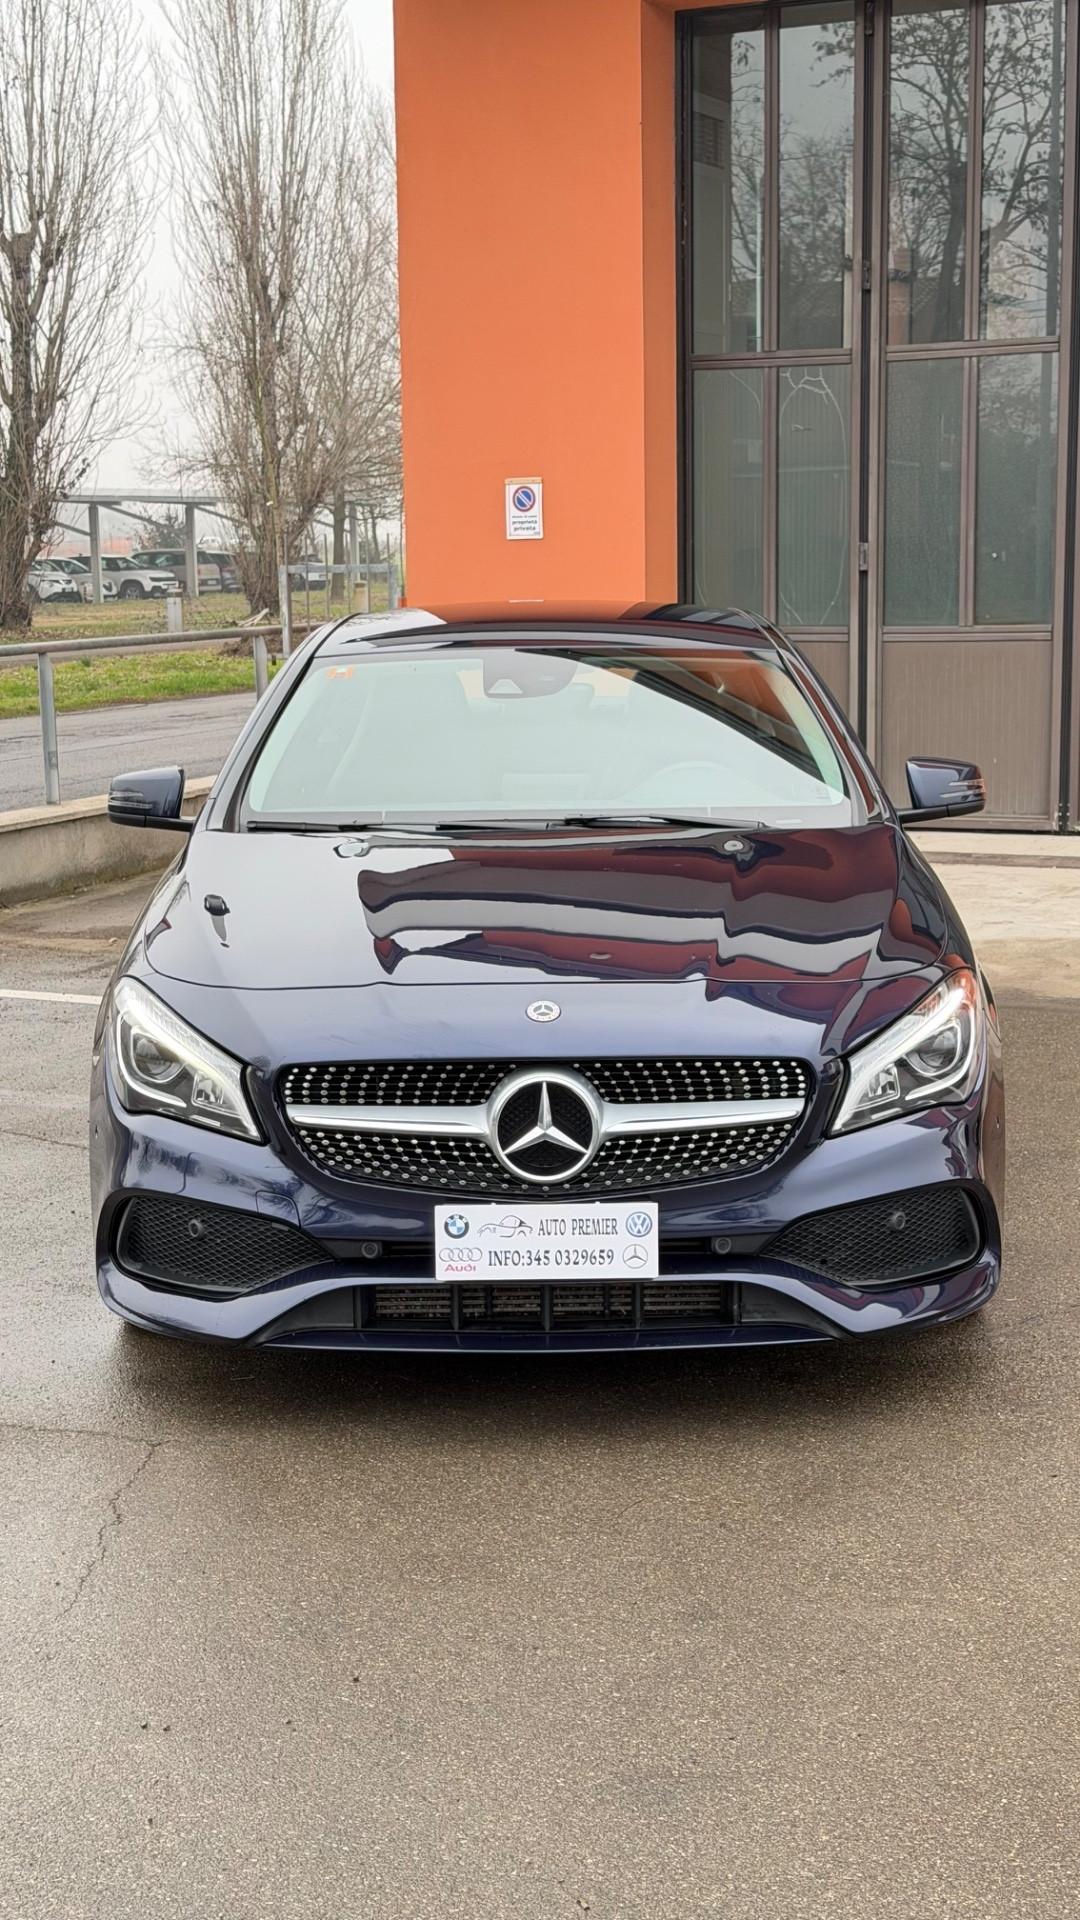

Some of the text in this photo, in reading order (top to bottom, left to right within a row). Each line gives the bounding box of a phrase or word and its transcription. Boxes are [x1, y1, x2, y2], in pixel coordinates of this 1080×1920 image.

[537, 1218, 618, 1236] AUTO PREMIER
[488, 1248, 614, 1266] INFO:345 0329659
[444, 1263, 476, 1272] Audi
